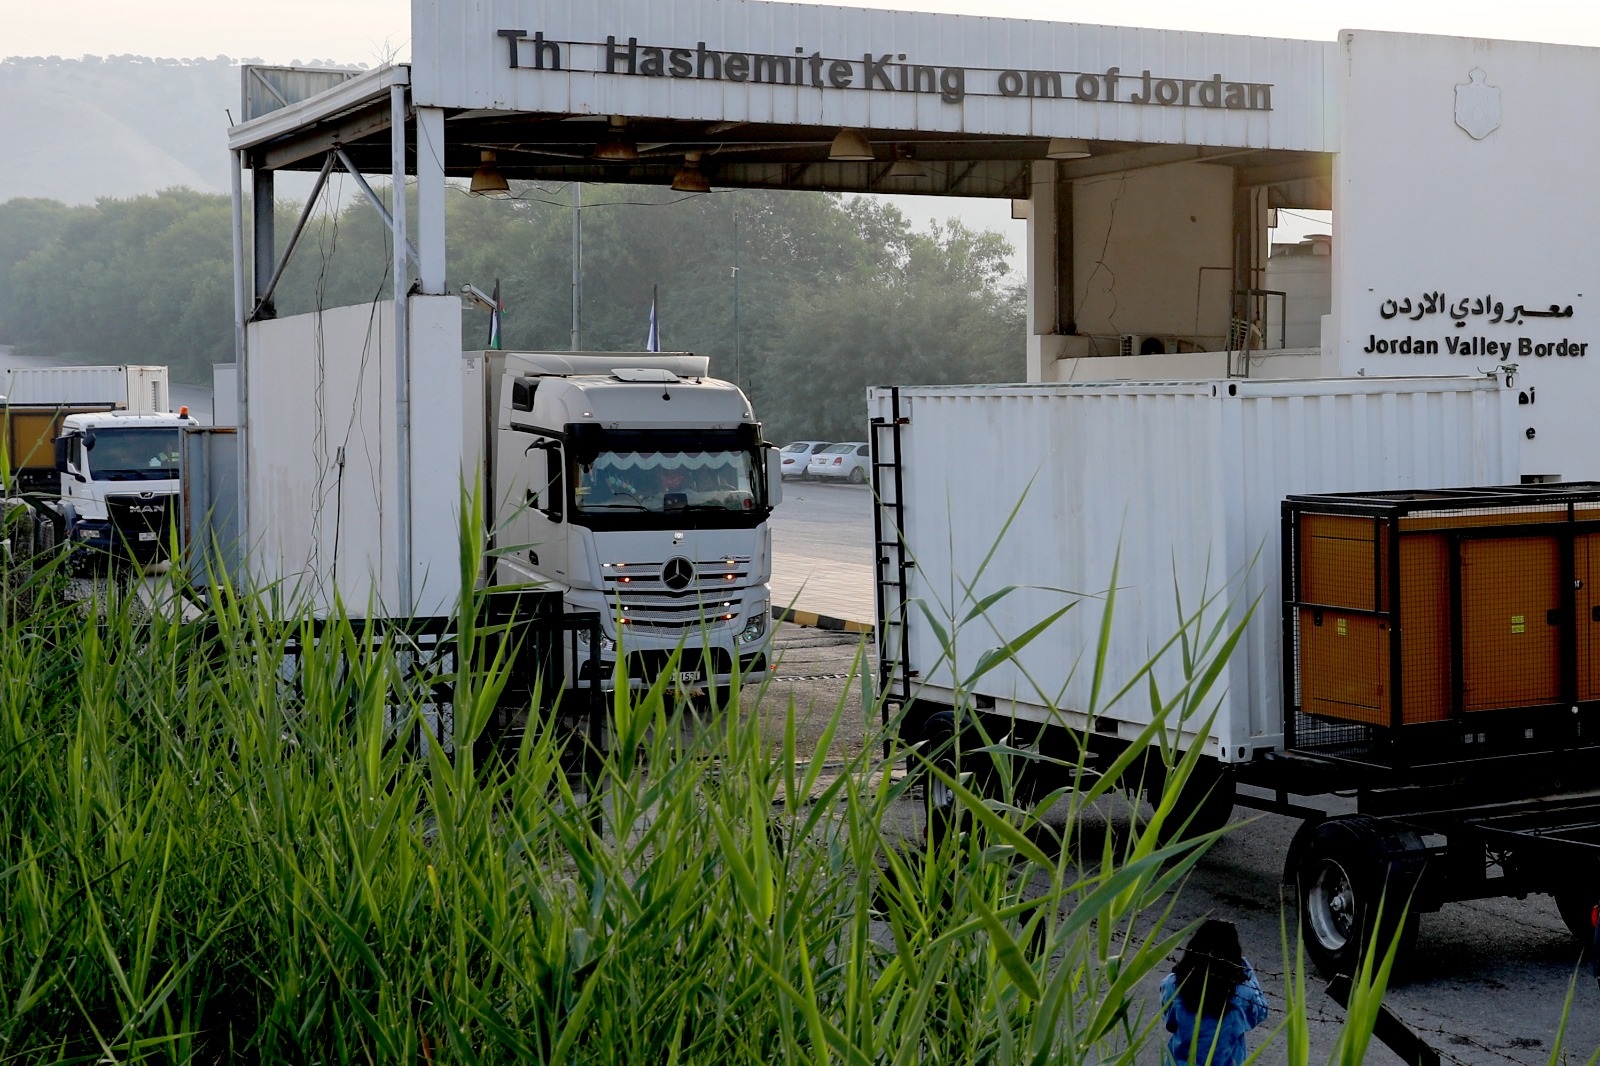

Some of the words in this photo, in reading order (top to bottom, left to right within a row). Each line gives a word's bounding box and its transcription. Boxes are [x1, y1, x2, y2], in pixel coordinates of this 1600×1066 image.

[606, 35, 854, 88] Hashemite
[1075, 67, 1120, 101] of
[1131, 70, 1272, 110] Jordan
[1380, 291, 1446, 321] الاردن
[1450, 294, 1504, 328] وادي
[1504, 304, 1574, 326] معبر
[1363, 334, 1439, 354] Jordan
[1445, 336, 1512, 361] Valley
[1518, 337, 1589, 358] Border
[129, 505, 165, 513] MAN
